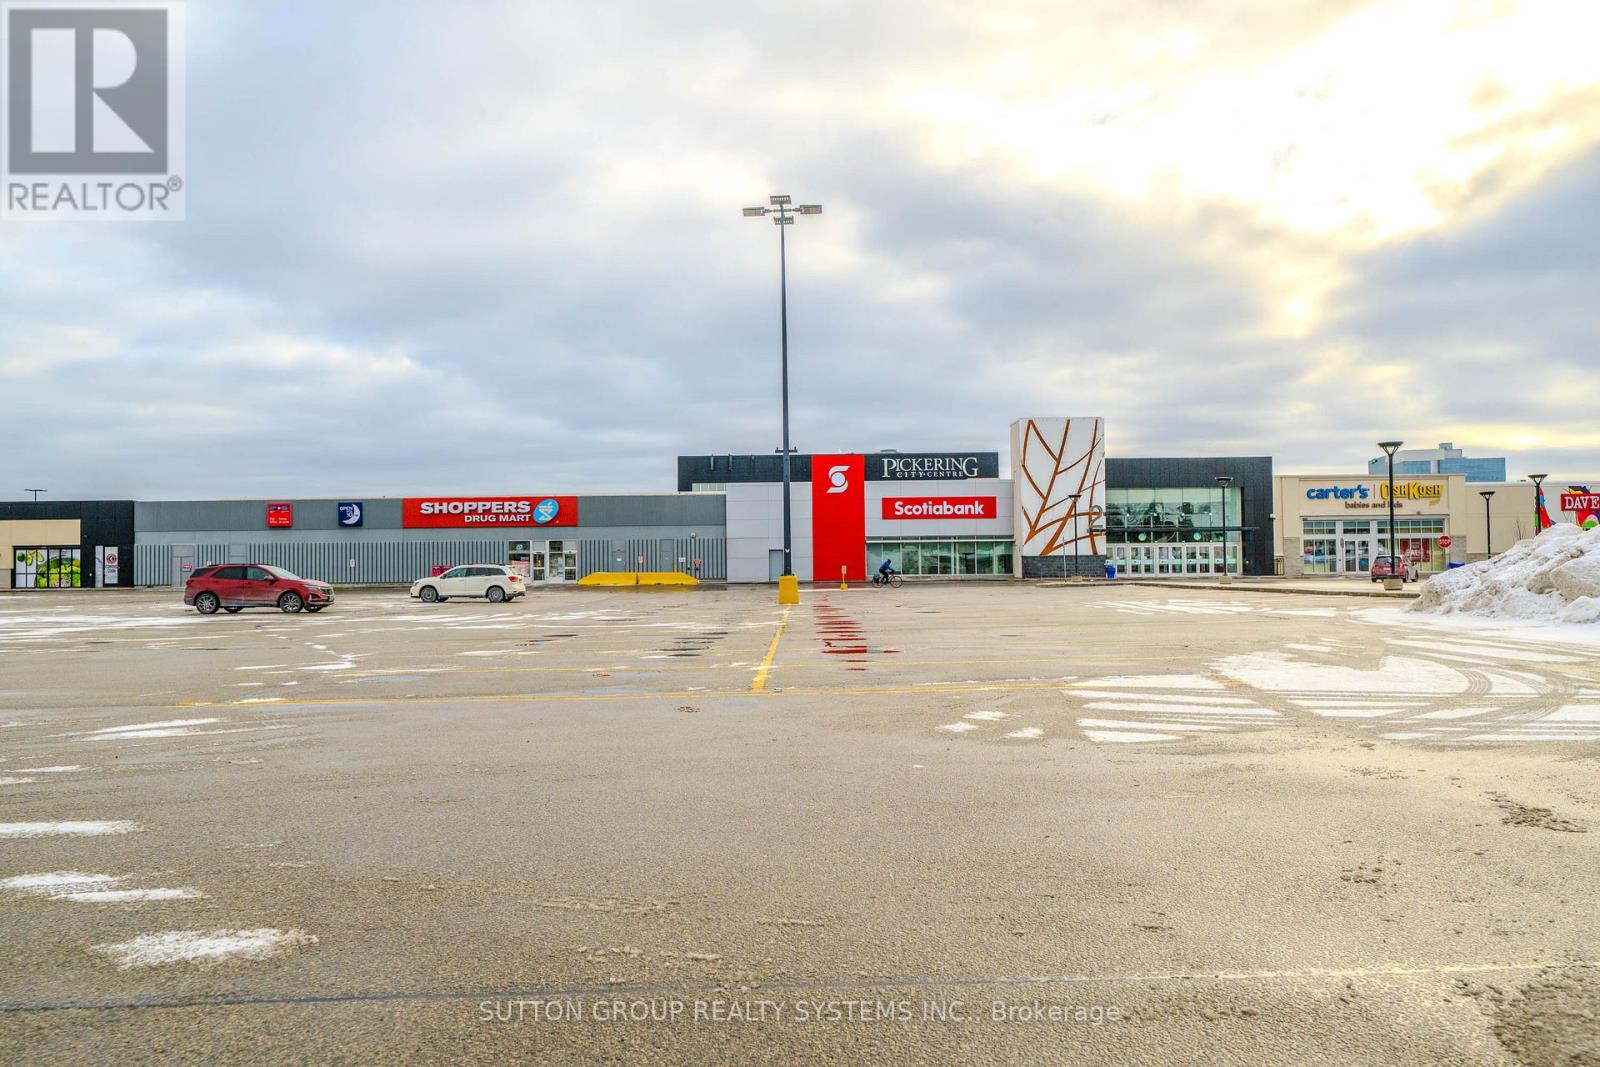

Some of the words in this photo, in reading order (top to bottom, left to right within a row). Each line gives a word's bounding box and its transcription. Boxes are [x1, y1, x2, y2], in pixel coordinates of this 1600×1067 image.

[881, 457, 979, 477] PICKERING
[1306, 485, 1370, 500] carter's
[420, 501, 531, 515] SHOPPERS
[894, 501, 984, 515] Scotiabank
[1371, 501, 1386, 509] and
[464, 515, 496, 523] DRUG
[499, 514, 531, 523] MART
